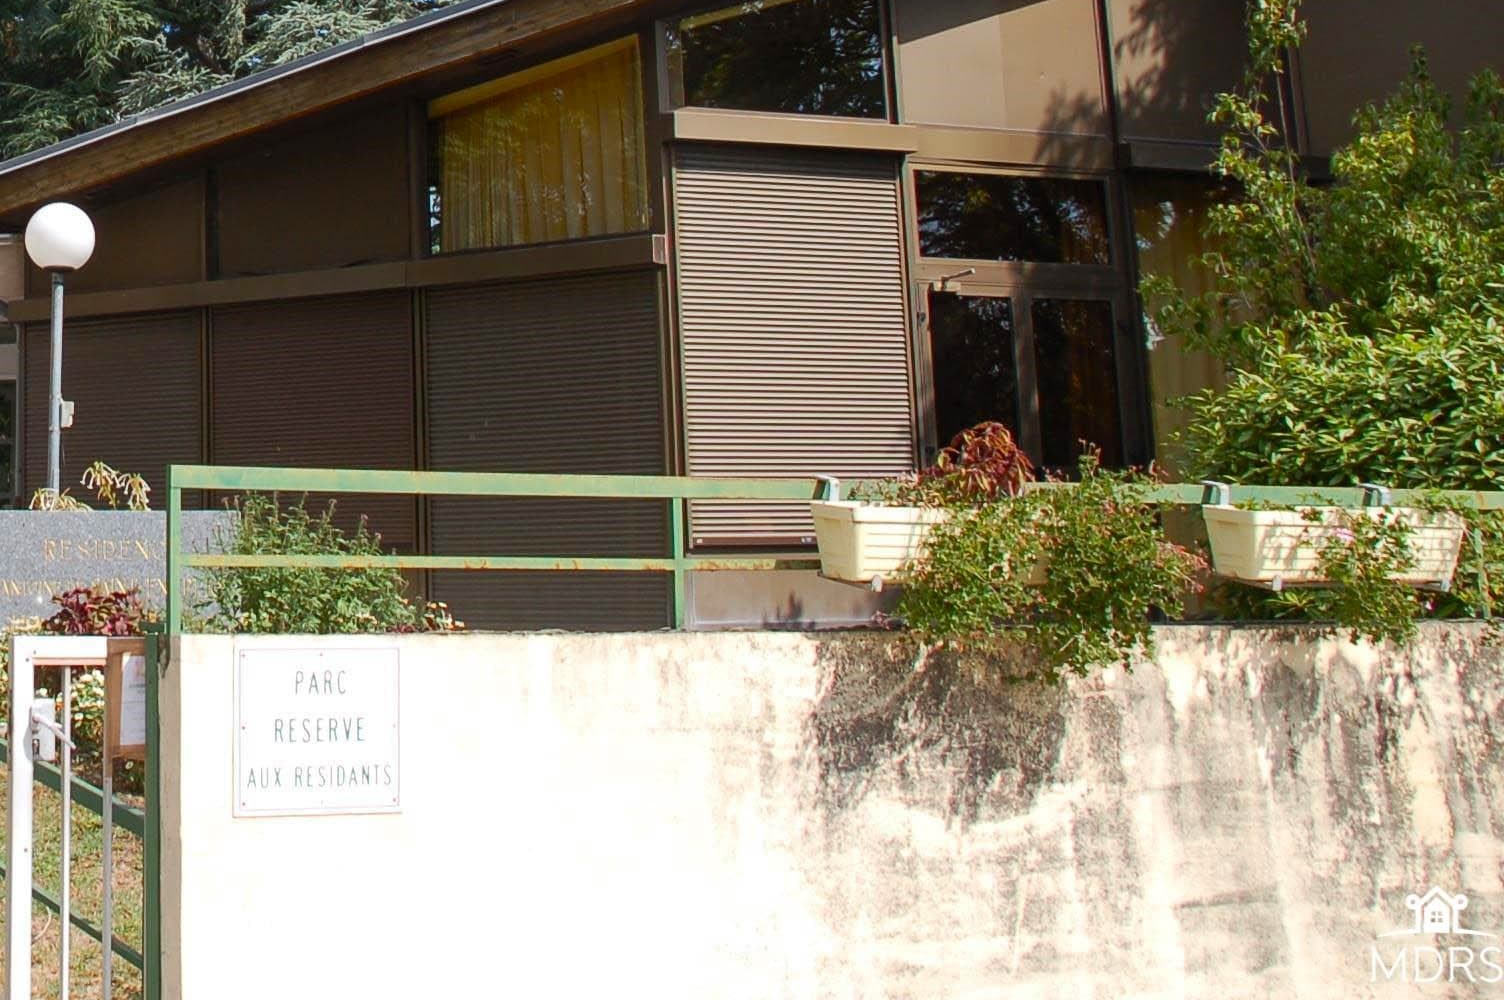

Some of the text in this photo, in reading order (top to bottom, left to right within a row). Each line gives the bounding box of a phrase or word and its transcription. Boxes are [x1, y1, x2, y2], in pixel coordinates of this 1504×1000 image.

[42, 539, 167, 561] RESIDENC
[295, 669, 347, 695] PARC
[274, 716, 366, 743] RESERVE
[247, 763, 393, 789] AUX RESIDANTS
